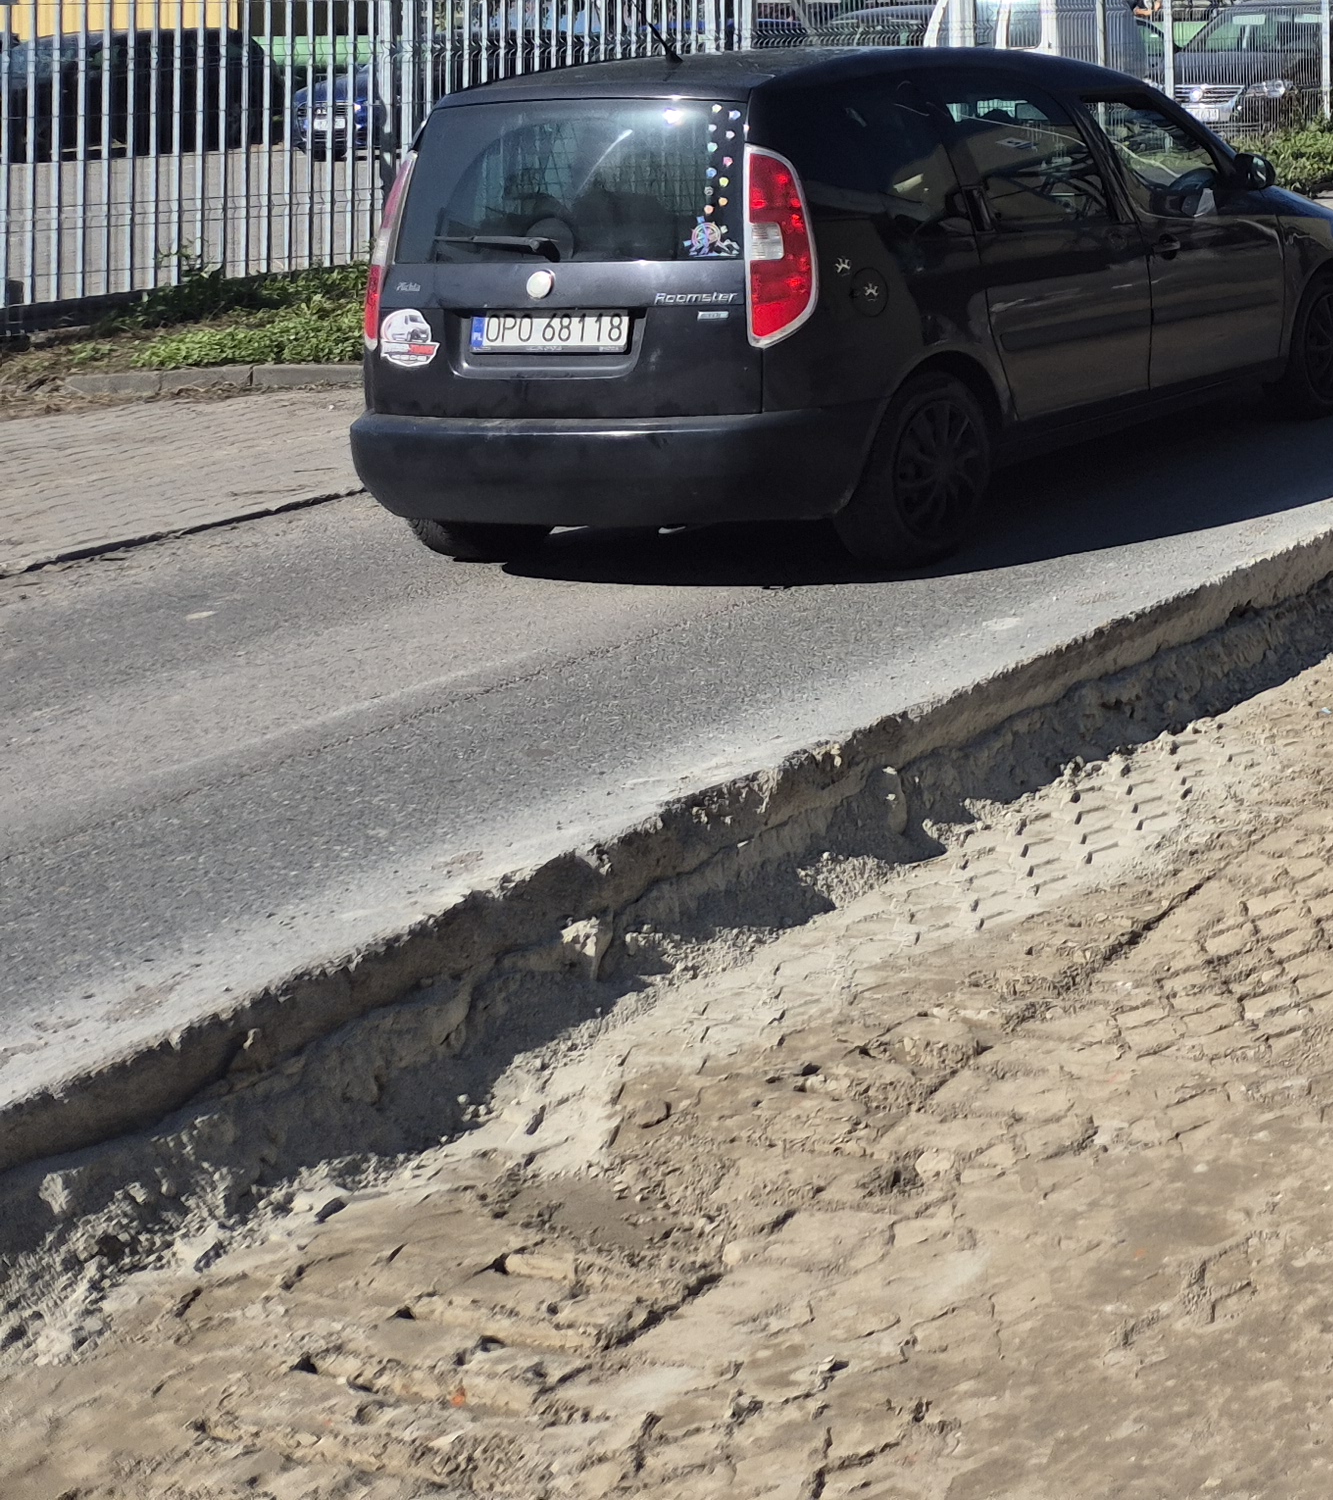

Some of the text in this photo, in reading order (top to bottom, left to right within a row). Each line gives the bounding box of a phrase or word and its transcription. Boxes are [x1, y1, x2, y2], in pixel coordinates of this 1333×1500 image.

[654, 291, 739, 306] Roomster
[486, 313, 623, 343] OPO 68118
